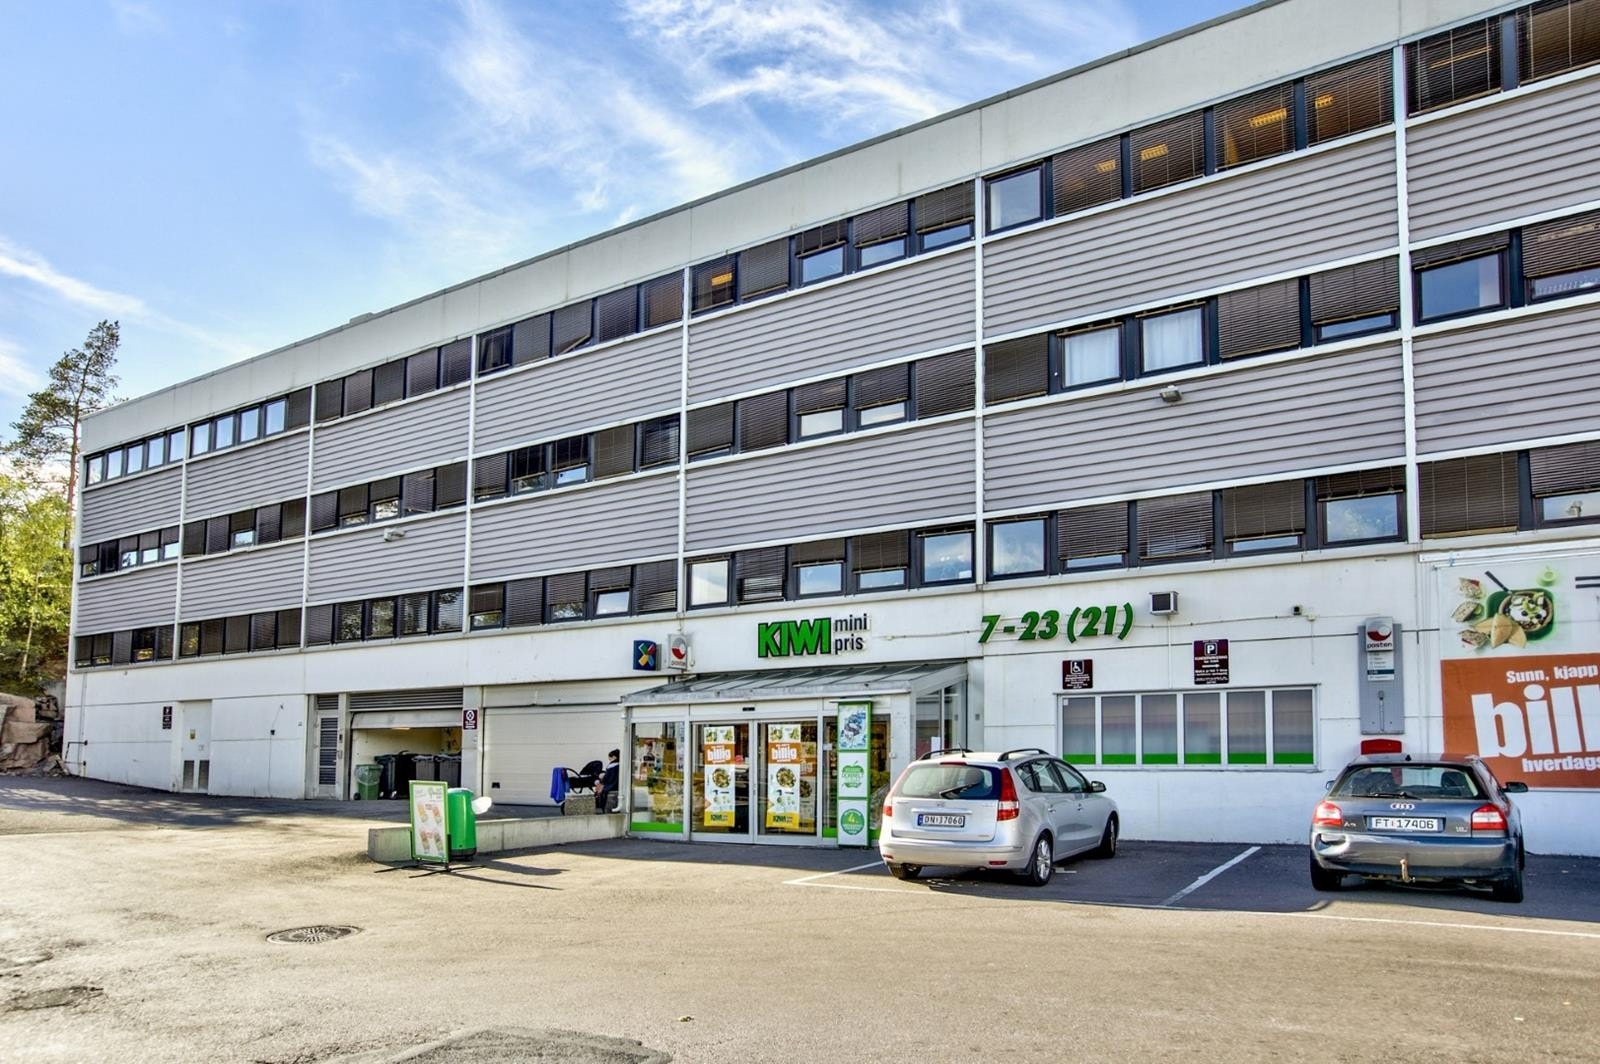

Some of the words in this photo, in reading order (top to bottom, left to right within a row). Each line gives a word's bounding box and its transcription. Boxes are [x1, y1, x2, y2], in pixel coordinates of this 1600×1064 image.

[1066, 602, 1134, 644] (21)
[757, 617, 832, 658] KIWI
[834, 613, 868, 632] mini
[834, 633, 864, 655] pris
[1553, 664, 1599, 680] kjapp
[1375, 818, 1389, 828] FT
[1396, 819, 1434, 829] 17406
